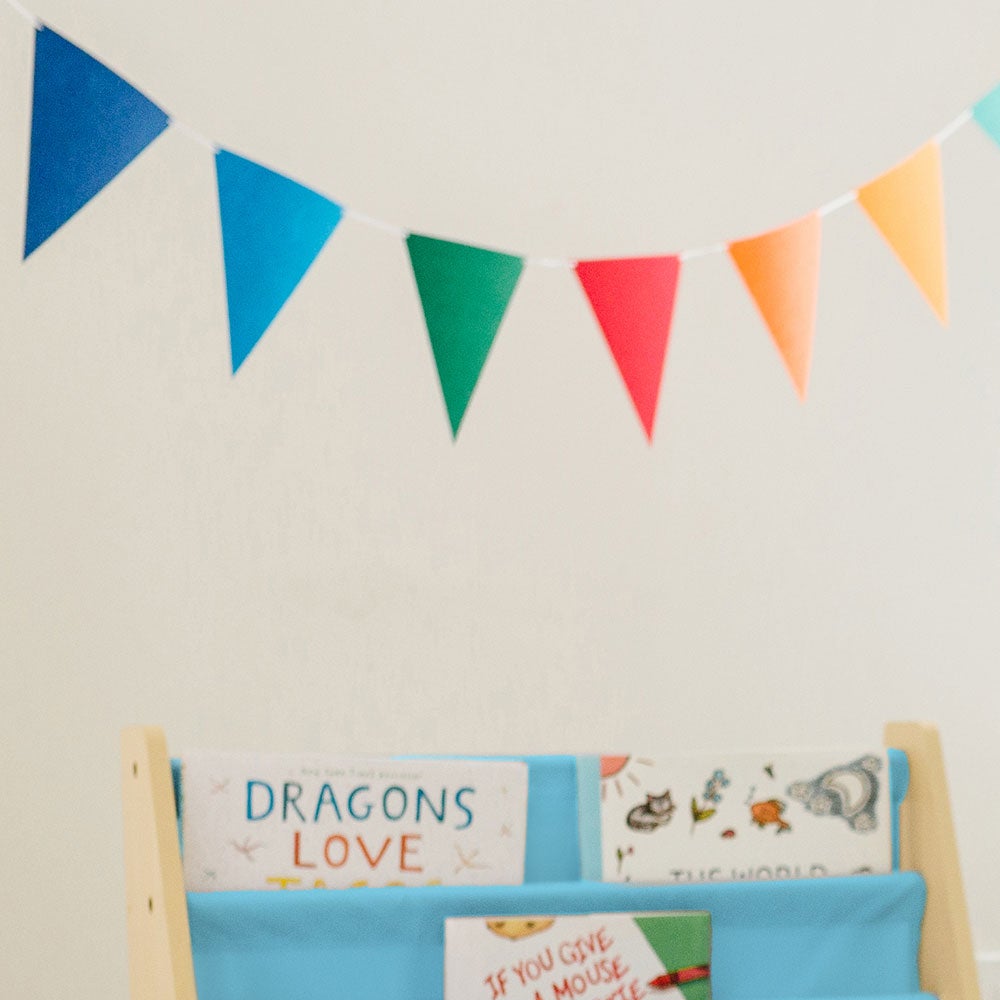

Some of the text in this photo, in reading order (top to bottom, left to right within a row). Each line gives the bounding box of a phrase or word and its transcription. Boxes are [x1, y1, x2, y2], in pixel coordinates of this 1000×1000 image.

[246, 780, 476, 830] DRAGONS
[293, 831, 423, 872] LOVE
[484, 926, 616, 1000] IF YOU GIVE
